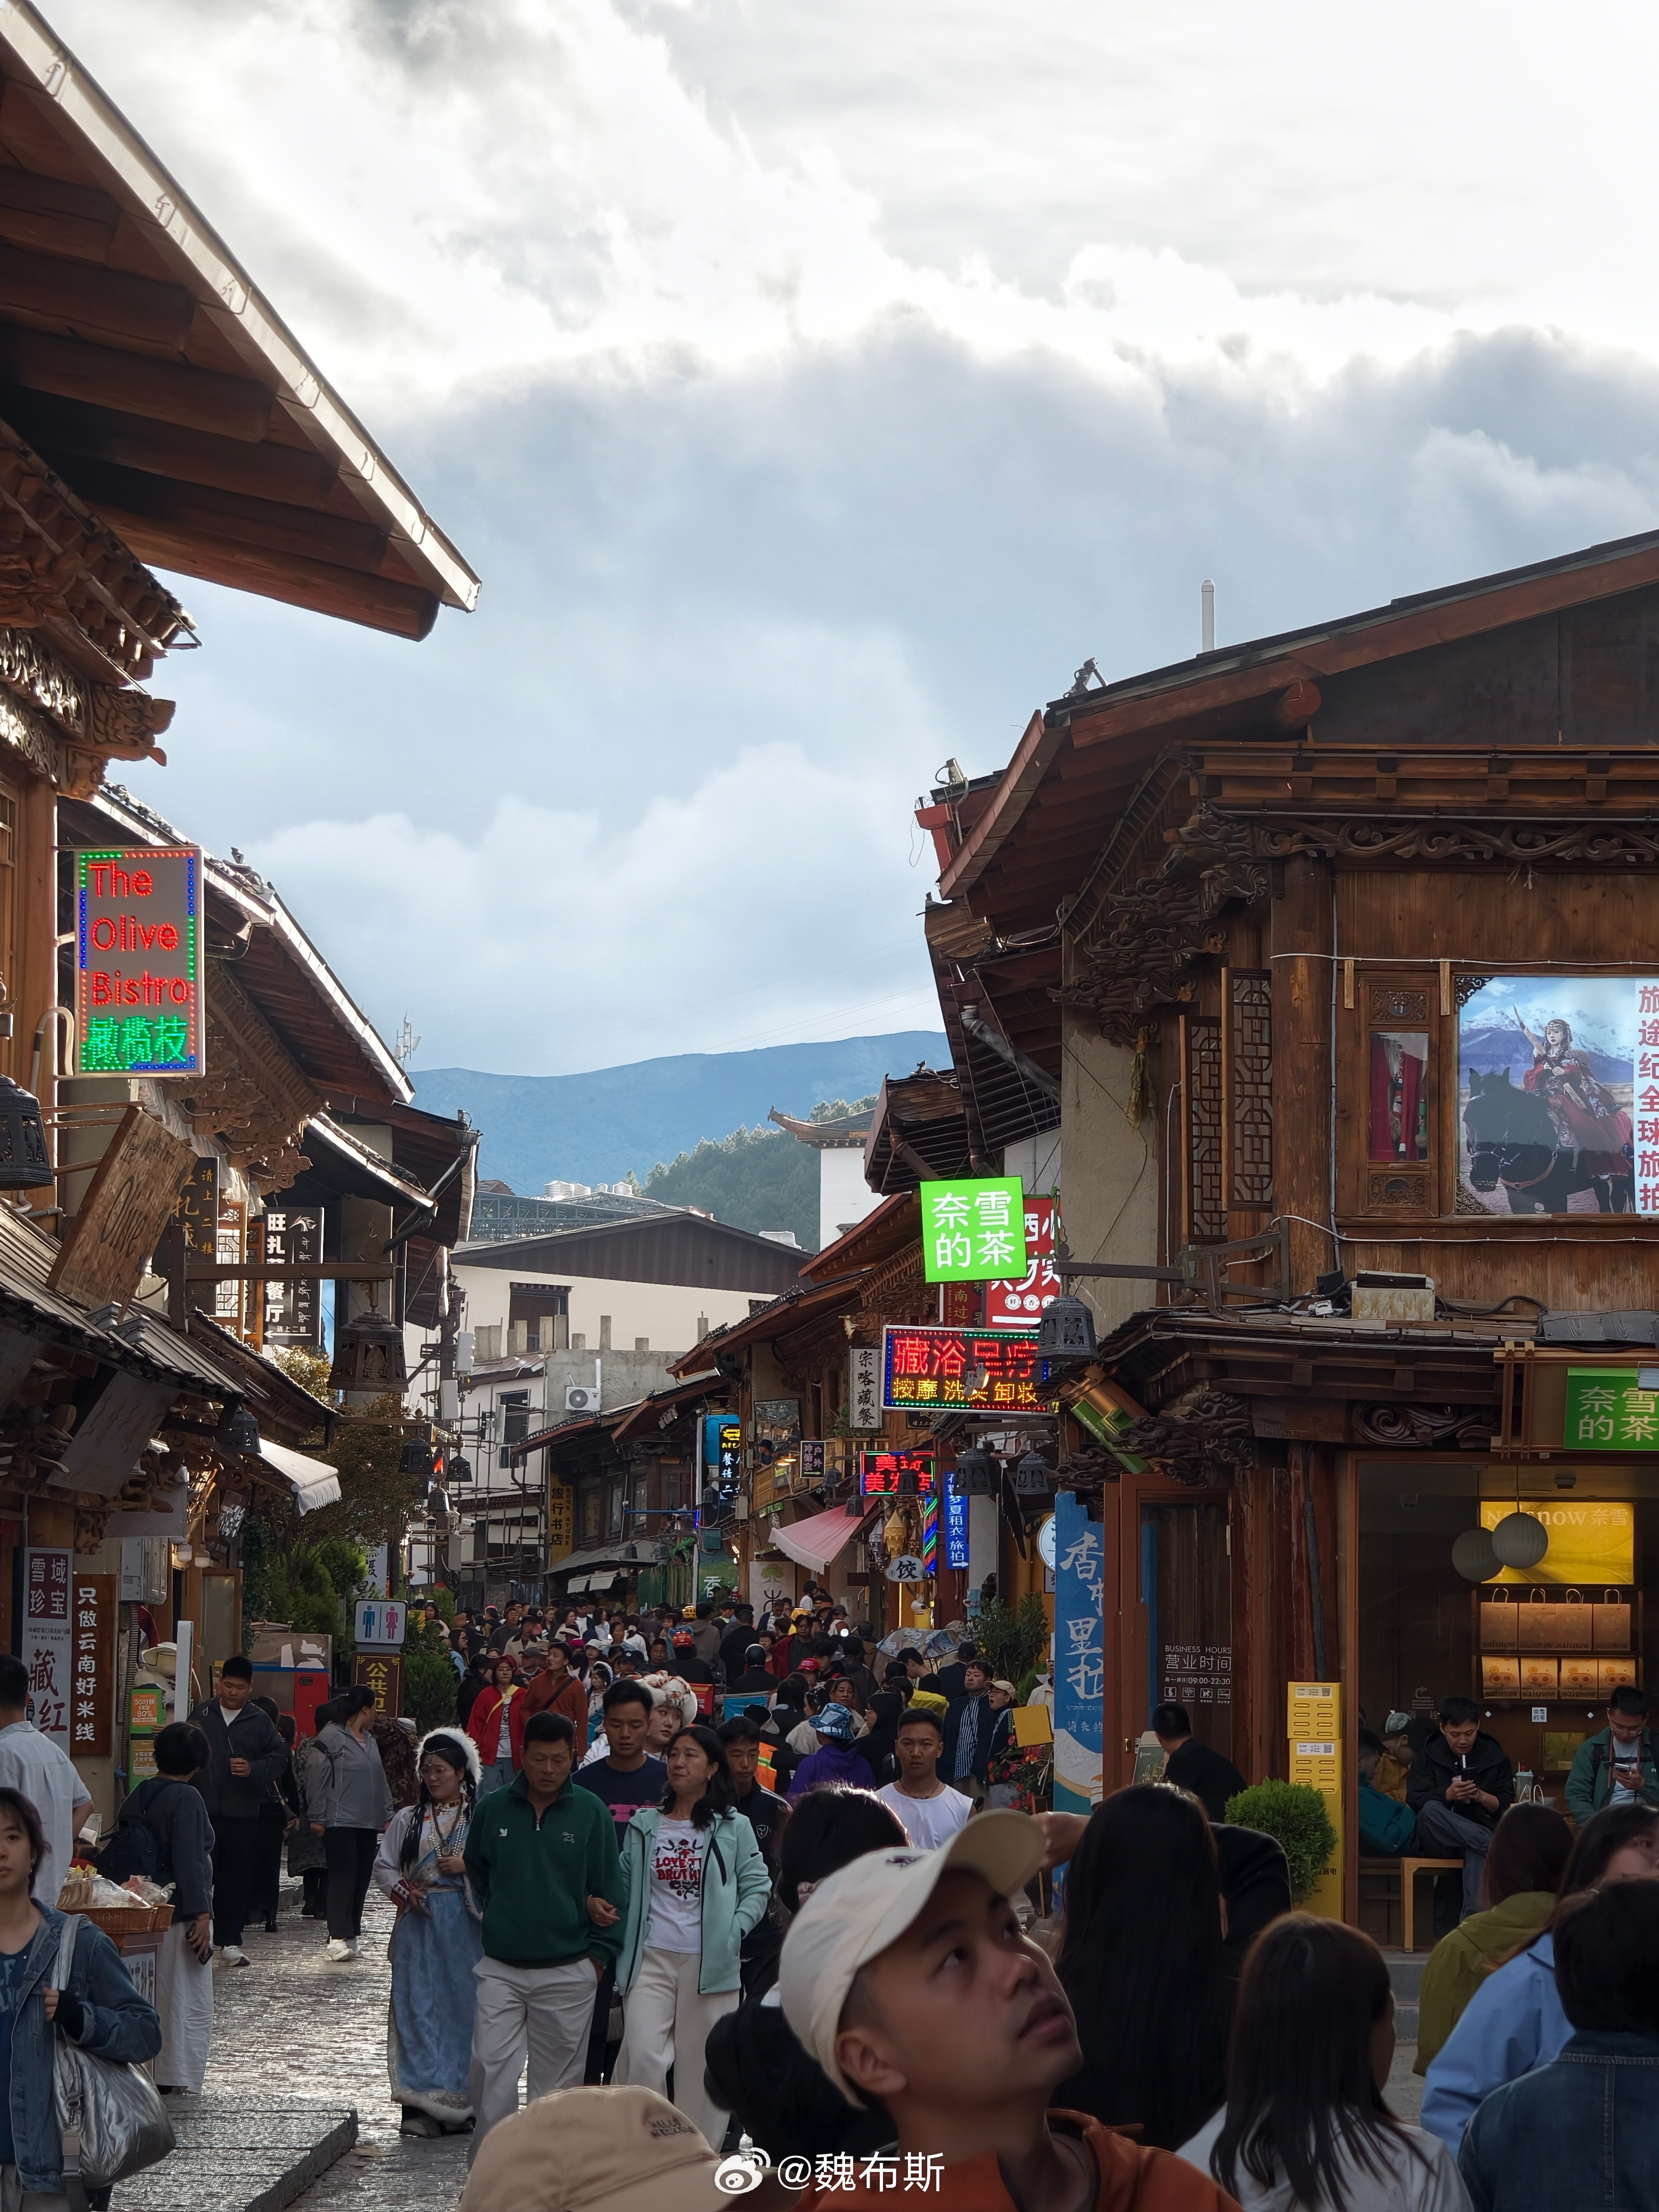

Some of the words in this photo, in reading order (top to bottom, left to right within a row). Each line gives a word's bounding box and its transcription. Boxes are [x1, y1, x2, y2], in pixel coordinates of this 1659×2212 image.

[89, 861, 153, 898] The
[91, 915, 178, 951] Olive
[92, 970, 188, 1007] Bistro
[932, 1191, 1013, 1230] 奈雪
[936, 1229, 1016, 1269] 的茶
[265, 1213, 286, 1323] 旺扎餐厅
[857, 1350, 875, 1426] 宗喀藏餐
[1578, 1386, 1659, 1413] 奈雪
[1578, 1414, 1659, 1441] 的茶
[550, 1487, 564, 1546] 旅行书店
[1590, 1508, 1629, 1527] 奈雪
[31, 1558, 67, 1584] 雪域
[896, 1560, 919, 1580] 饺
[30, 1588, 66, 1615] 珍宝
[1165, 1645, 1201, 1653] BUSINESS
[1205, 1646, 1232, 1654] HOURS
[1165, 1654, 1232, 1671] 营业时间
[75, 1587, 98, 1742] 只做云南好米线
[1188, 1677, 1231, 1685] 09:00-22:30
[656, 1857, 687, 1869] LOVE
